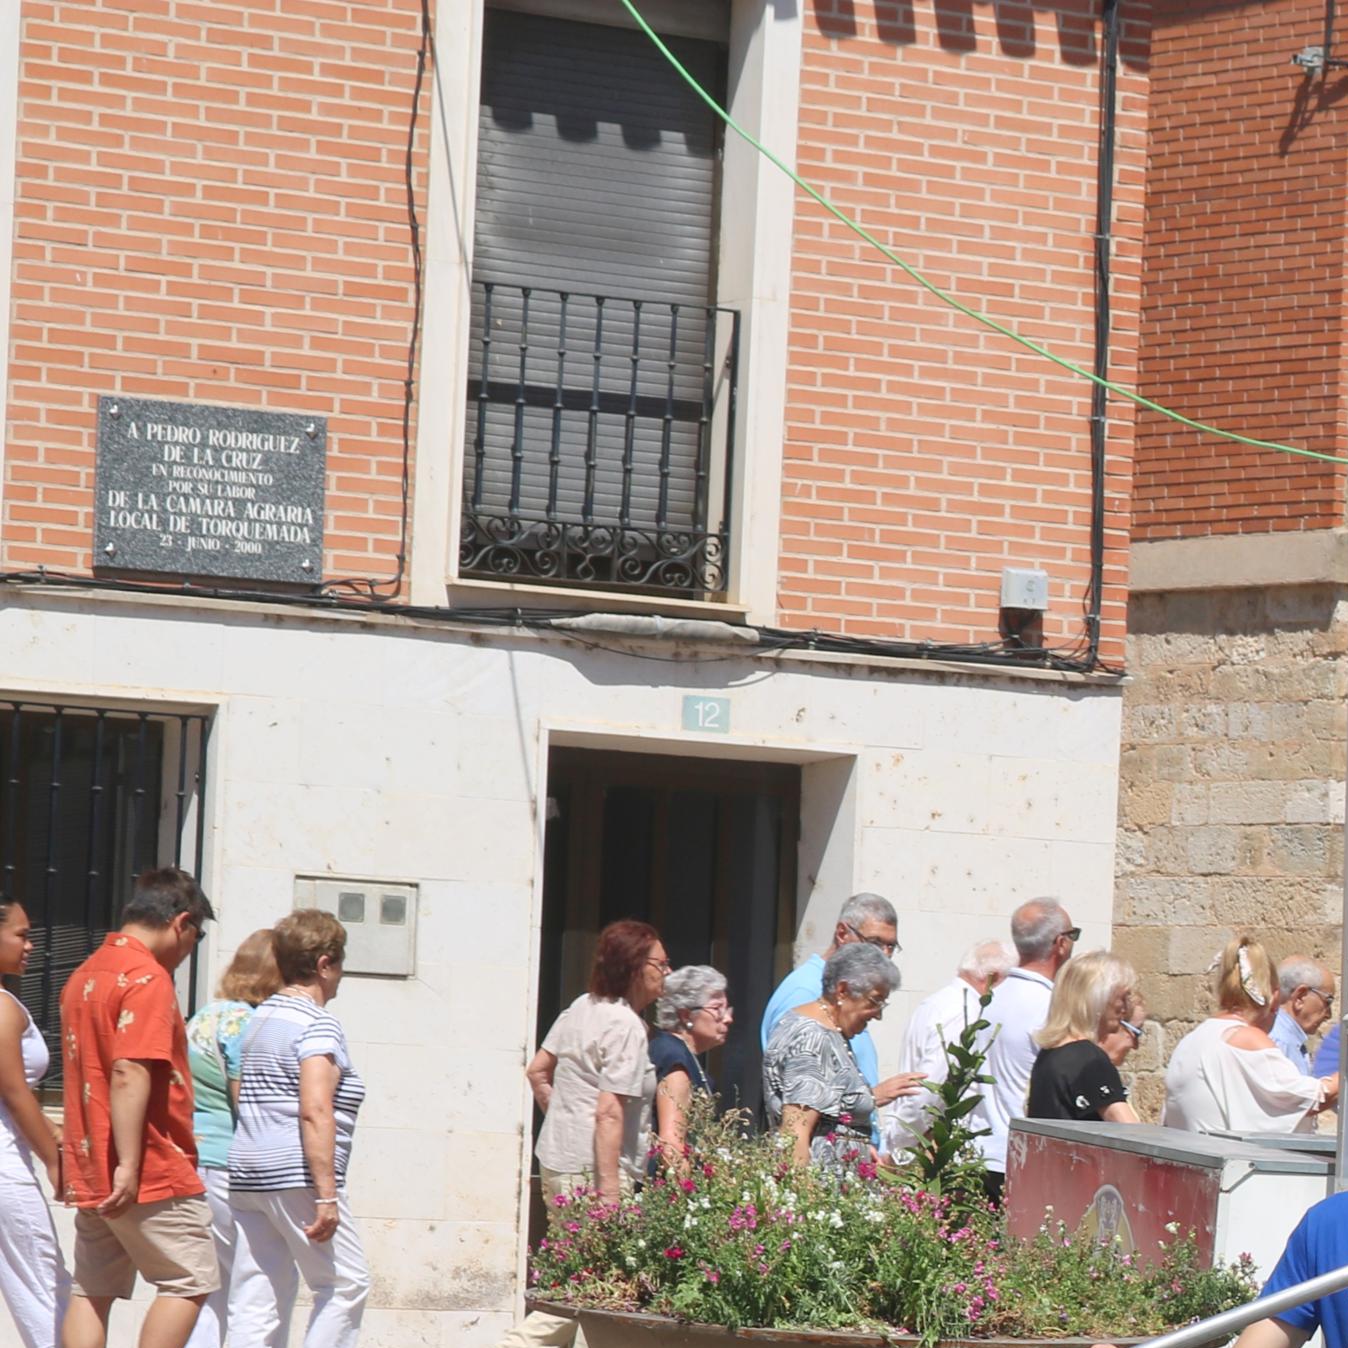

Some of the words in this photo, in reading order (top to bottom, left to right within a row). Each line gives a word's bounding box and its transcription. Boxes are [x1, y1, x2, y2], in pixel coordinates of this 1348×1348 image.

[127, 421, 139, 440] A
[146, 422, 201, 444] PEDRO
[208, 429, 302, 454] RODRIGUEZ
[163, 445, 186, 463] DE
[193, 449, 214, 466] LA
[221, 450, 263, 470] CRUZ
[151, 463, 169, 477] EN
[172, 465, 274, 487] RECONOCIMIENTO
[168, 479, 194, 495] POR
[198, 482, 215, 496] SU
[216, 483, 257, 501] LABOR
[107, 489, 131, 508] DE
[137, 492, 160, 512] LA
[166, 495, 236, 518] CAMARA
[243, 502, 315, 525] AGRARIA
[109, 509, 163, 532] LOCAL
[168, 514, 192, 534] DE
[198, 517, 312, 545] TORQUEMADA
[159, 533, 174, 548] 23
[186, 535, 221, 553] JUNIO
[233, 539, 263, 555] 2000
[693, 701, 720, 728] 12
